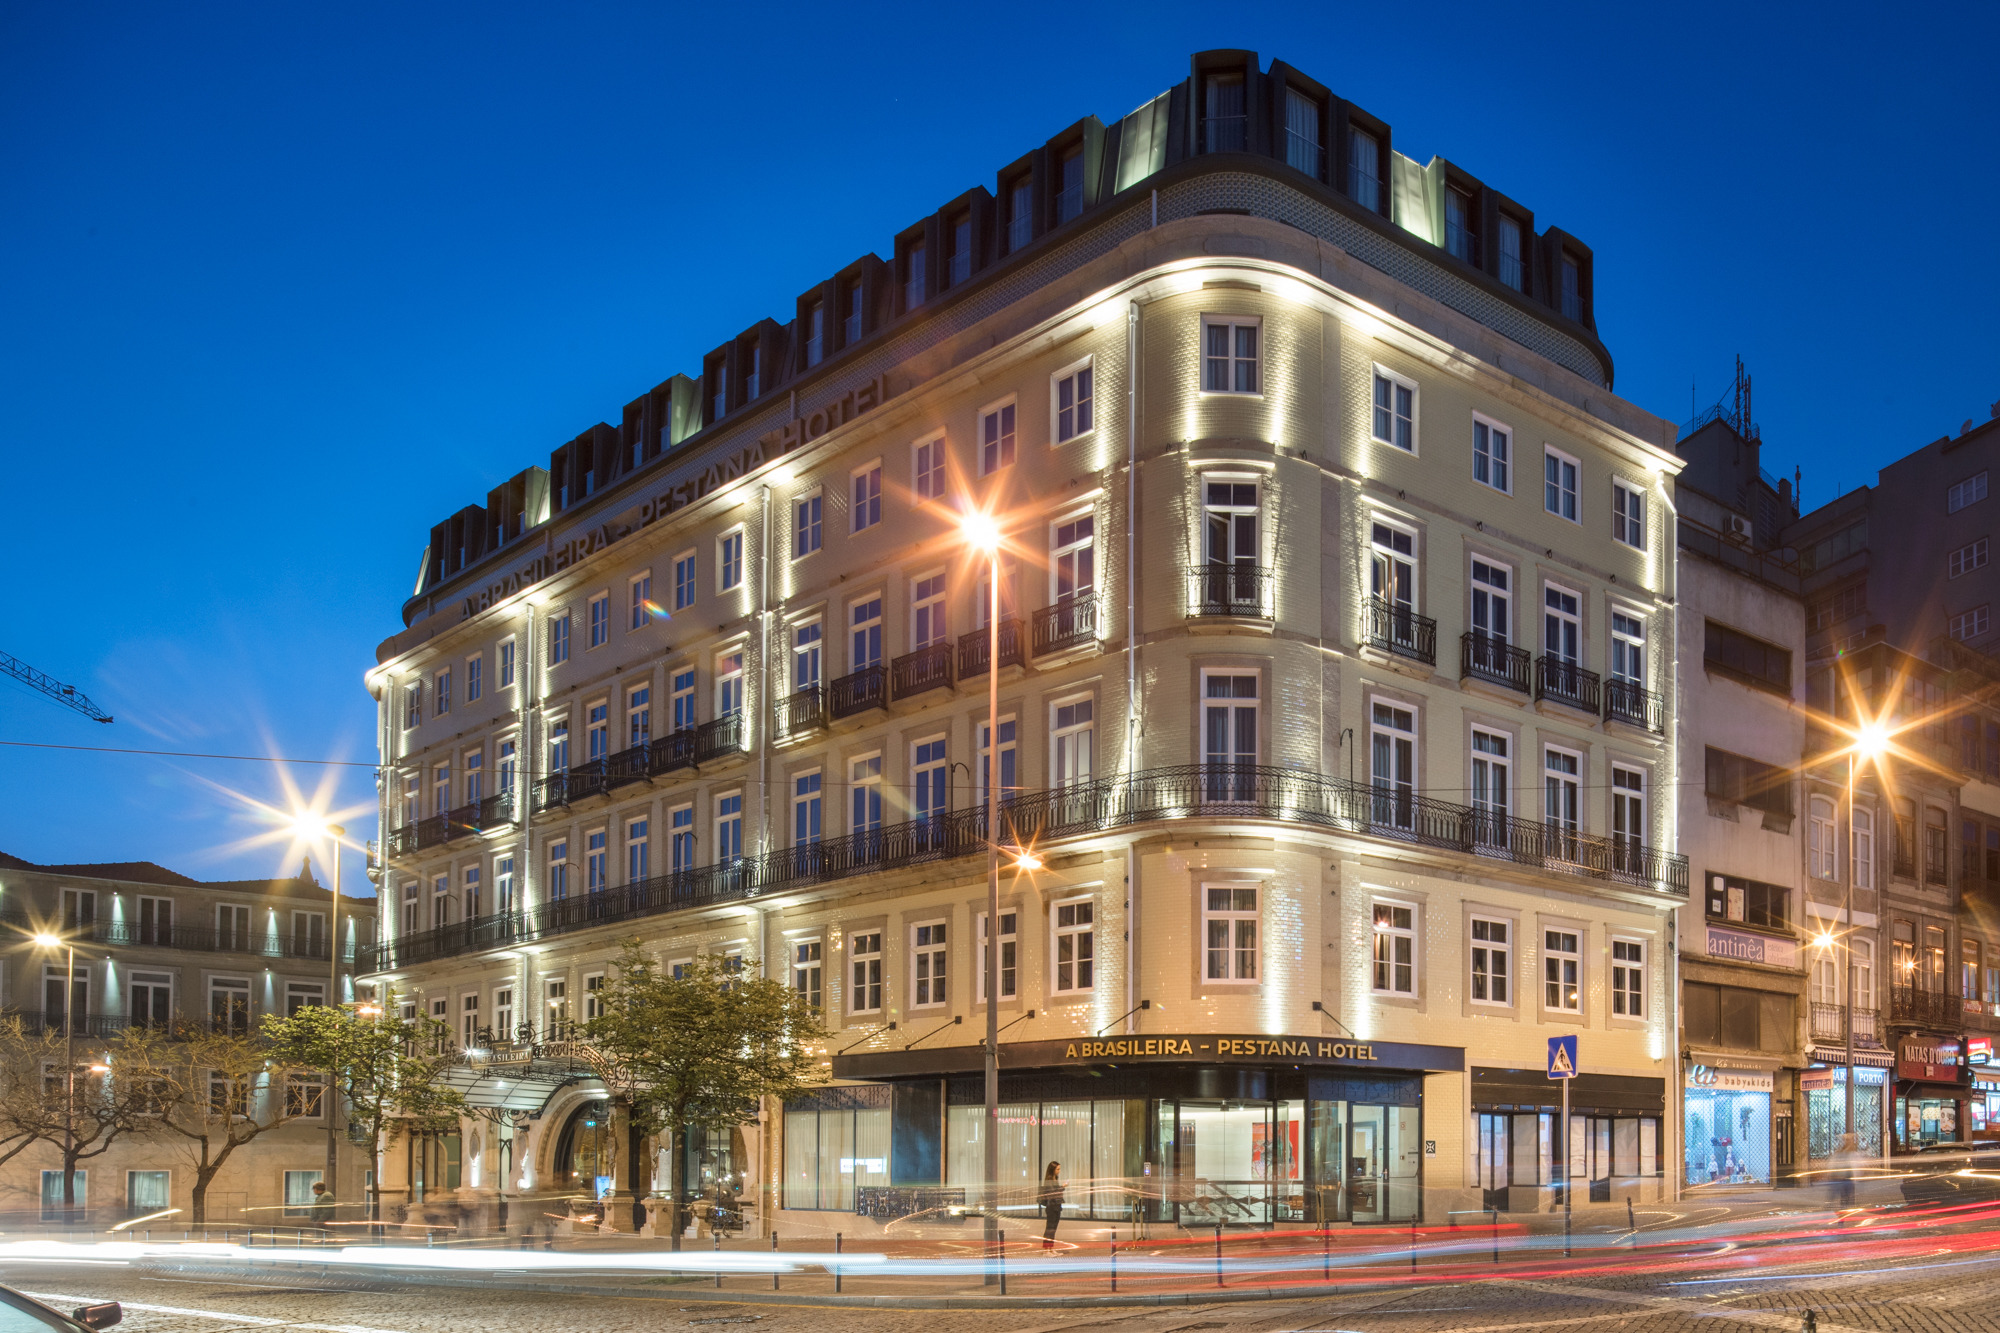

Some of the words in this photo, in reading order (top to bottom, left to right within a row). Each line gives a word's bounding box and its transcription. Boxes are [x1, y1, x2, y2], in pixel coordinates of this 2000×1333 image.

[1709, 937, 1763, 960] antinêa
[1065, 1043, 1078, 1058] A
[1082, 1039, 1193, 1057] BRASILEIRA
[1218, 1039, 1311, 1057] PESTANA
[1318, 1042, 1378, 1060] HOTEL
[1904, 1045, 1928, 1063] NATAS
[1859, 1073, 1883, 1083] PORTO
